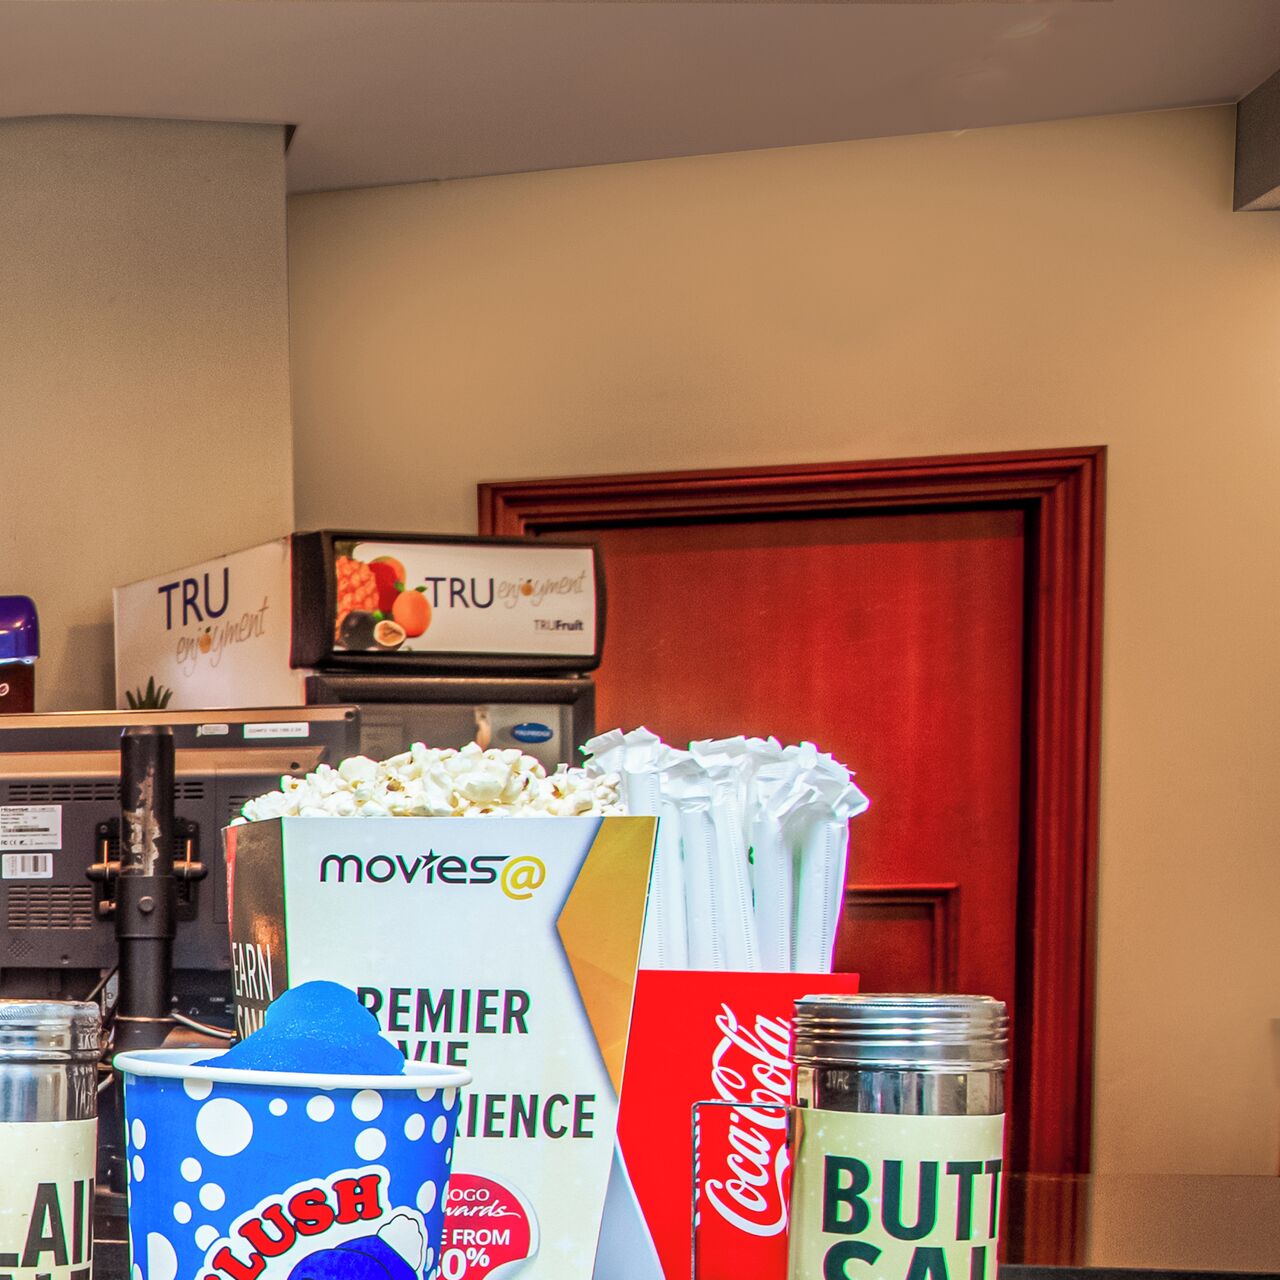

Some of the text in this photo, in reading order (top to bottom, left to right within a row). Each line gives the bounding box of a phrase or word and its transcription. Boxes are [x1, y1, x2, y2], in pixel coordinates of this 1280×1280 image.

[157, 567, 230, 631] TRU
[424, 576, 494, 609] TRU
[319, 848, 546, 901] movies@
[232, 942, 273, 1002] EARN
[357, 986, 531, 1034] REMIER
[452, 1228, 510, 1246] FROM
